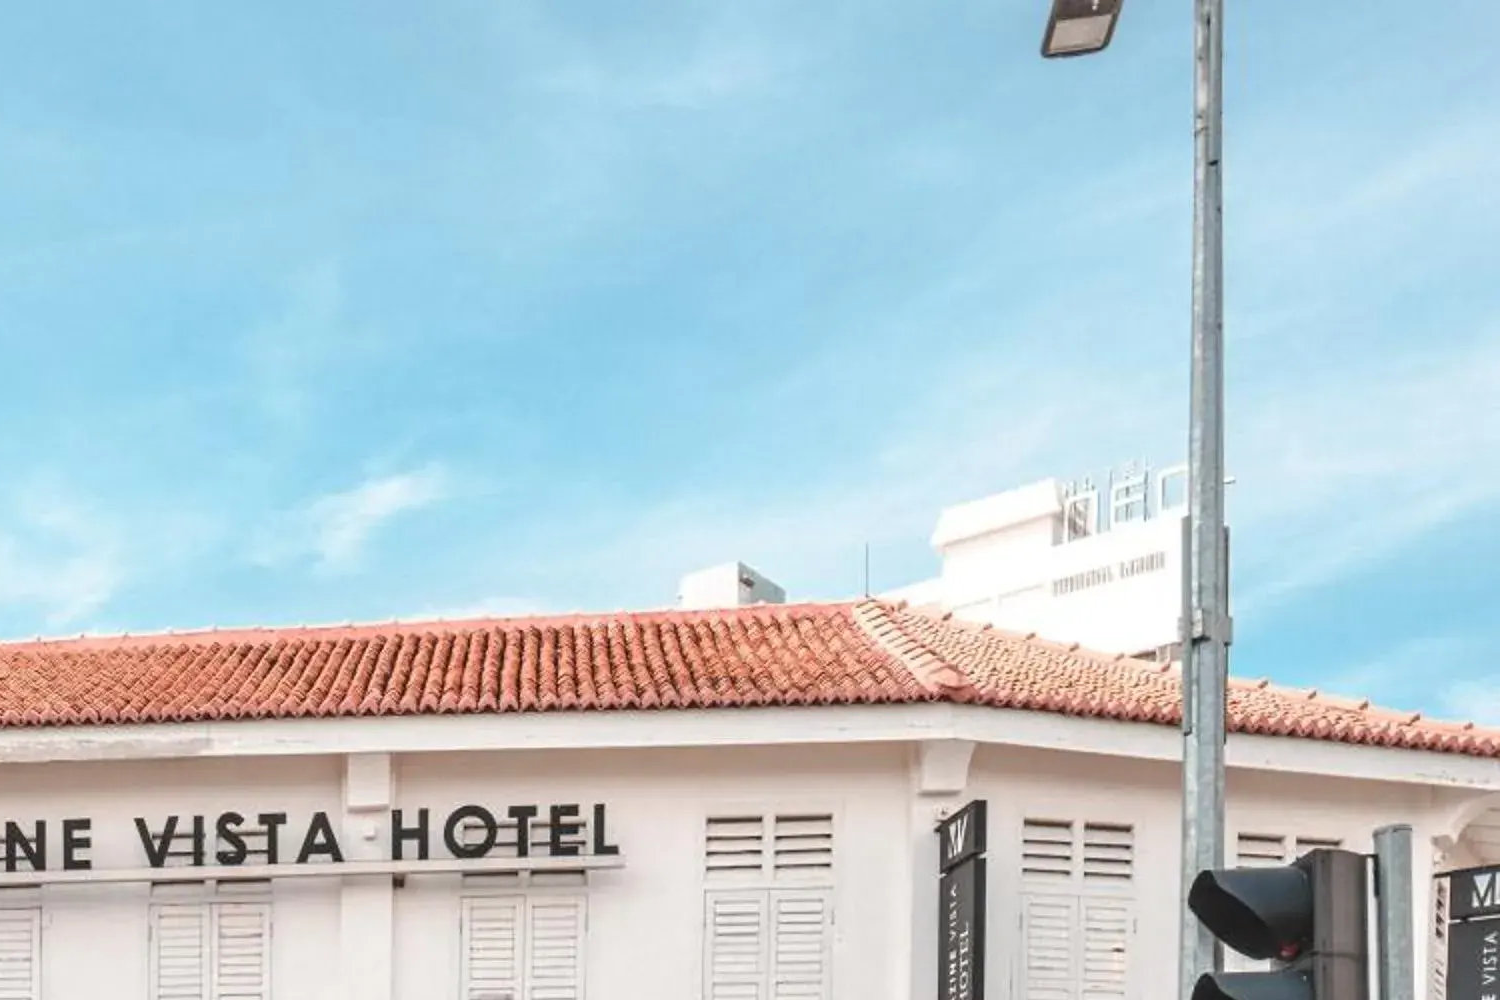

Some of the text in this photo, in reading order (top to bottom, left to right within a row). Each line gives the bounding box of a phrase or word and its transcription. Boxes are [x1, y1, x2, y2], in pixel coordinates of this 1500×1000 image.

[135, 812, 345, 867] VISTA
[391, 804, 620, 860] HOTEL
[949, 883, 958, 942] VISTA
[1481, 931, 1499, 985] VISTA
